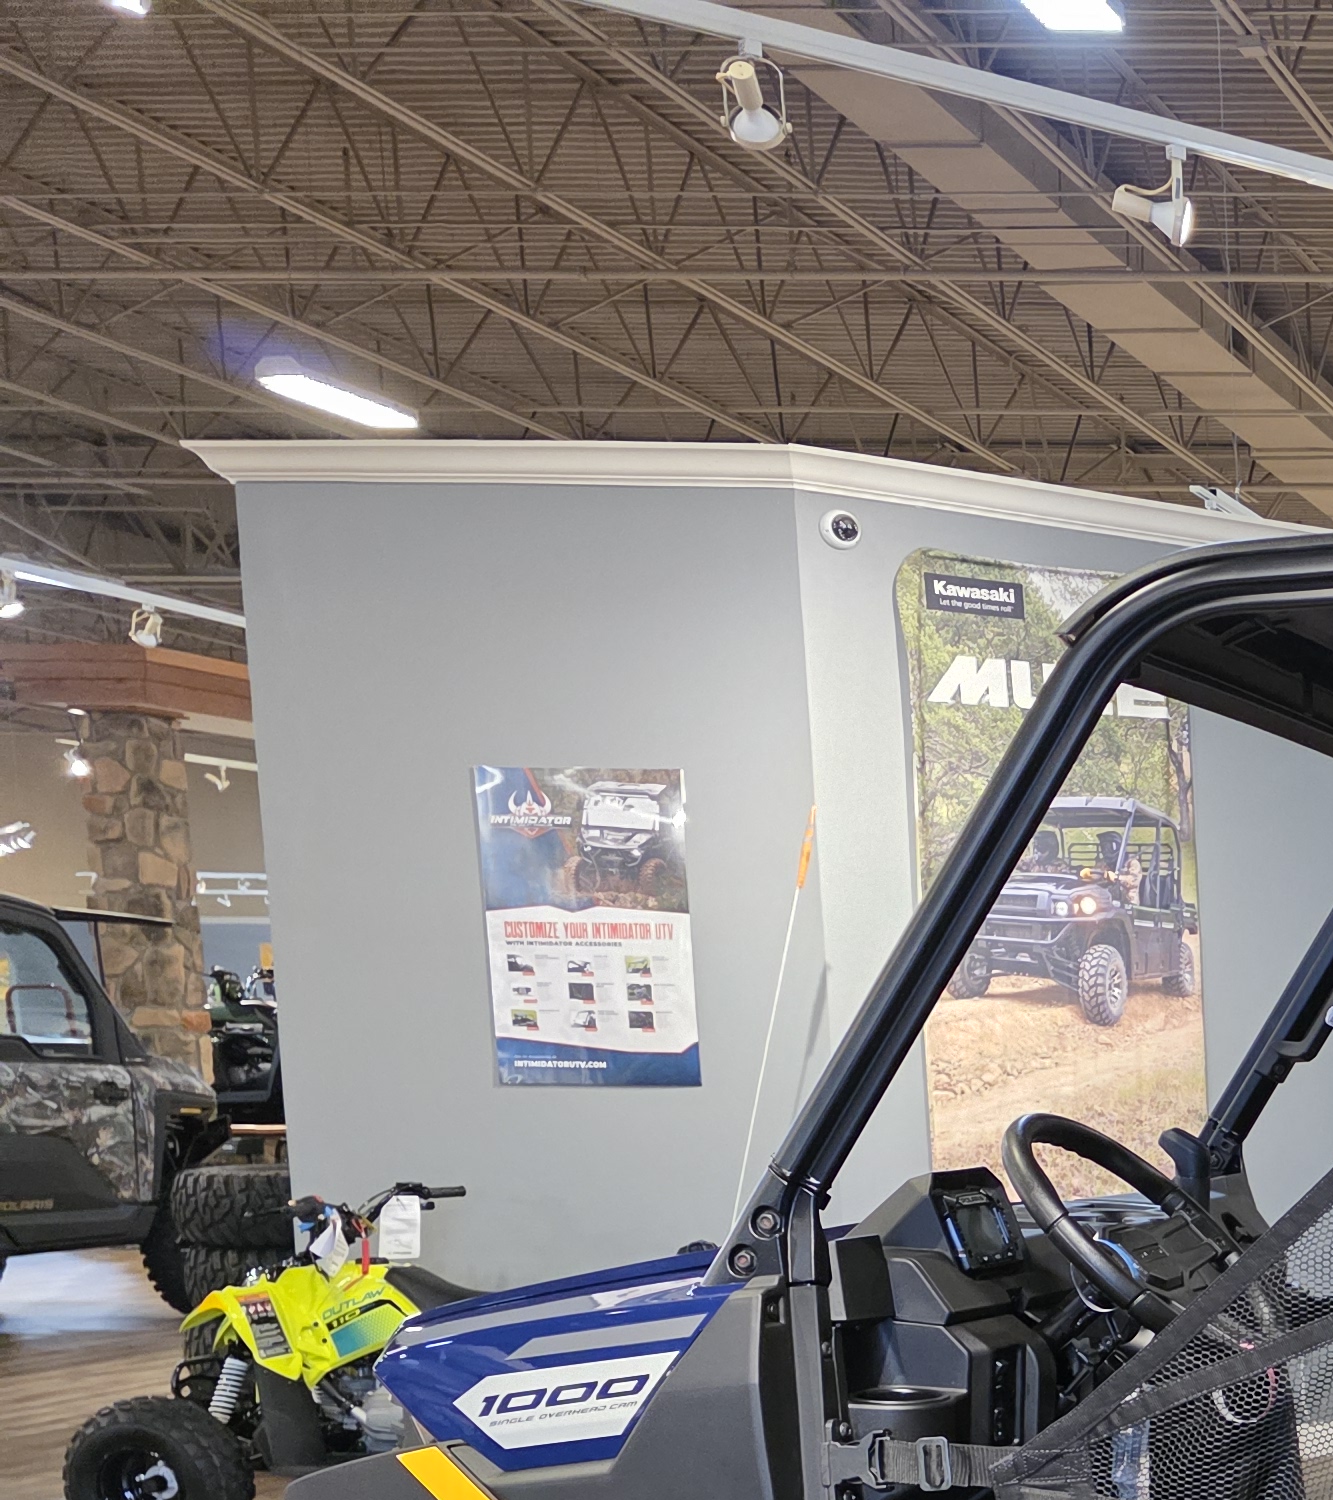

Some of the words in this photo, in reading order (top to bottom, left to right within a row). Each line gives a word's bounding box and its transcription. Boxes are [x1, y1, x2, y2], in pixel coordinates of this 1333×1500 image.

[933, 579, 1015, 604] Kawasaki
[939, 598, 950, 607] Let
[951, 599, 963, 608] the
[963, 601, 981, 611] good
[982, 602, 1000, 612] times
[927, 655, 1171, 720] MUE
[490, 815, 572, 825] INTIMIDATOR
[504, 920, 560, 939] CUSTOMIZE
[563, 921, 588, 939] YOUR
[592, 922, 651, 940] INTIMIDATOR
[655, 923, 674, 941] UTV
[514, 1060, 607, 1069] INTIMIDATORUTV.COM
[322, 1287, 386, 1320] OUTLAW
[330, 1307, 361, 1328] 110
[478, 1373, 650, 1418] 1000
[488, 1415, 534, 1428] SINGLE
[538, 1405, 608, 1420] OVERHEAD
[608, 1400, 638, 1411] CAM
